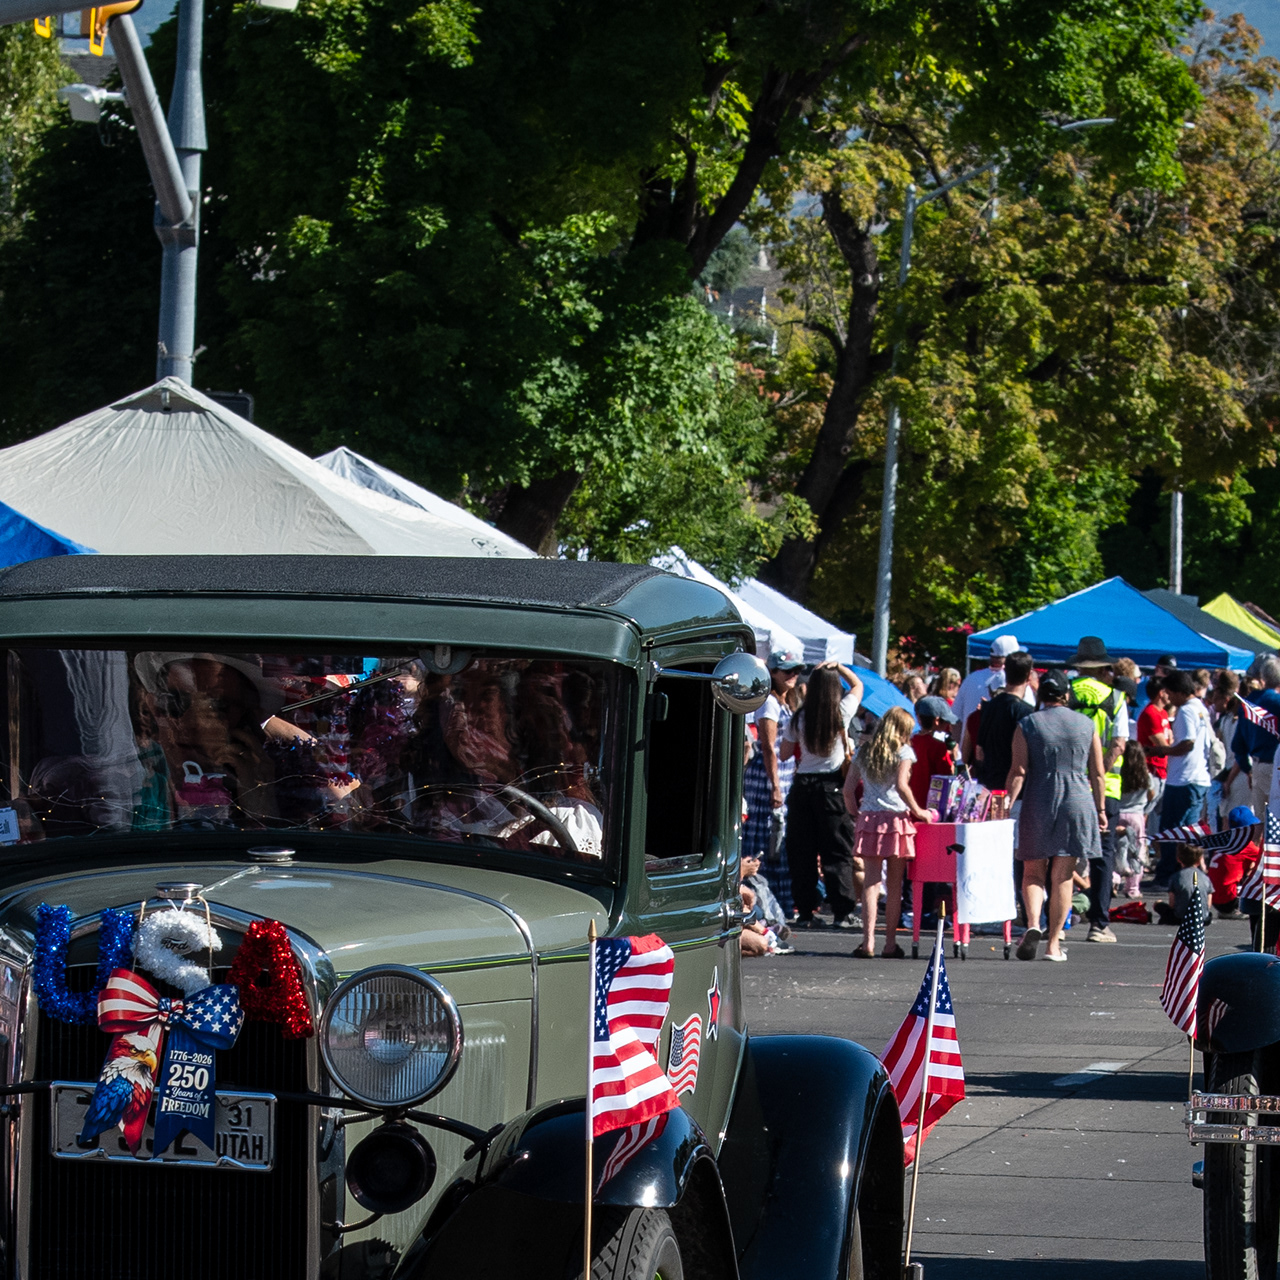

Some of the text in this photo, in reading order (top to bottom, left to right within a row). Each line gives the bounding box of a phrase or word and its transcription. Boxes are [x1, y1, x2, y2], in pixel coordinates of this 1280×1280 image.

[169, 1050, 213, 1065] 1776-2026
[167, 1064, 210, 1091] 250
[171, 1086, 203, 1102] Years of
[161, 1096, 211, 1119] FREEDOM
[228, 1104, 253, 1128] 31
[216, 1132, 264, 1161] UTAH
